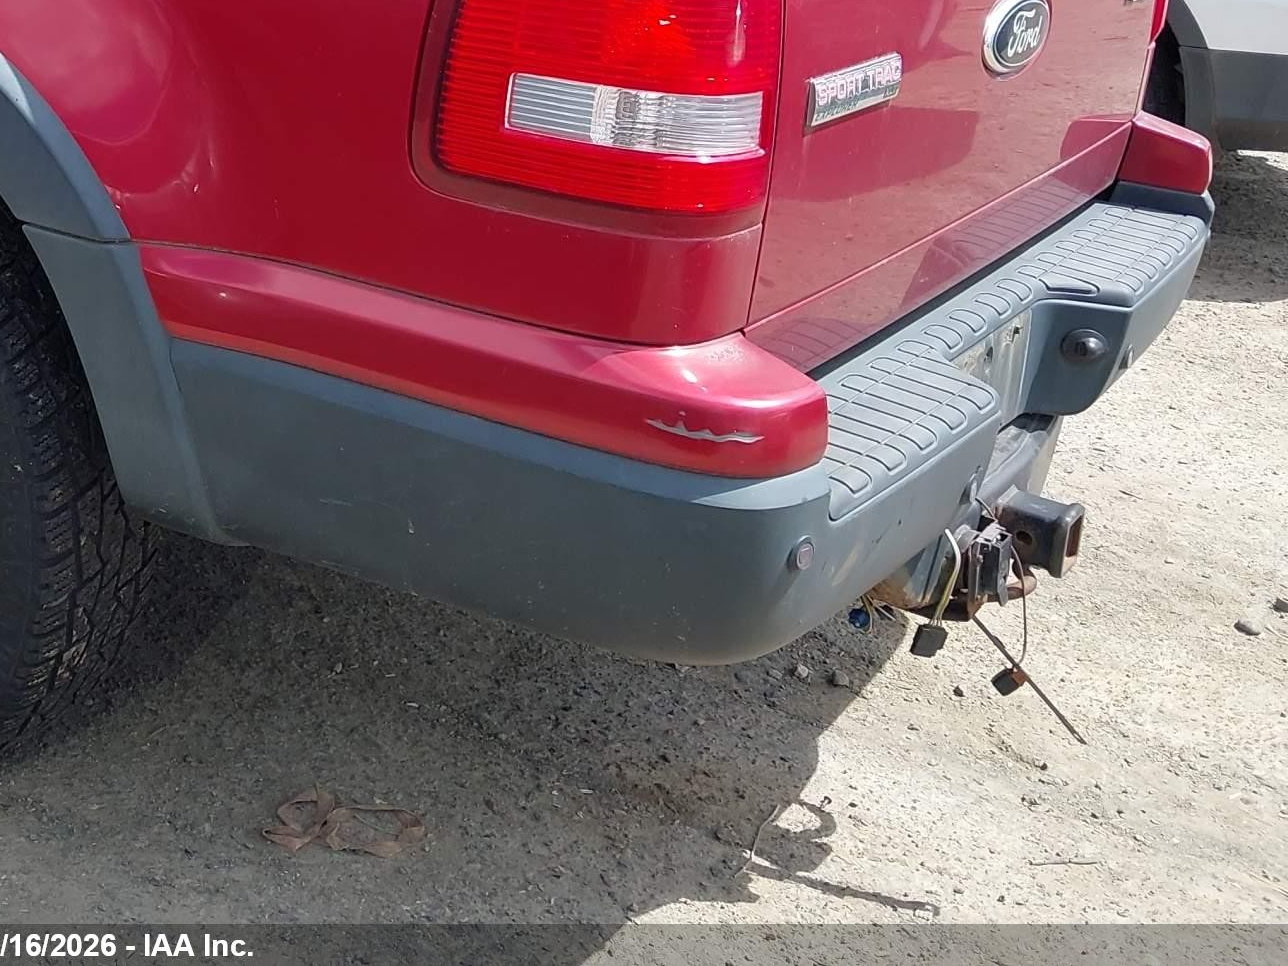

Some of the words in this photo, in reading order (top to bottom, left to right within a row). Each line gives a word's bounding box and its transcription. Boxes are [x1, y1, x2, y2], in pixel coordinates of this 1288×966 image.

[1006, 8, 1044, 58] Ford
[815, 72, 865, 107] SPORT
[865, 58, 902, 91] TRAC
